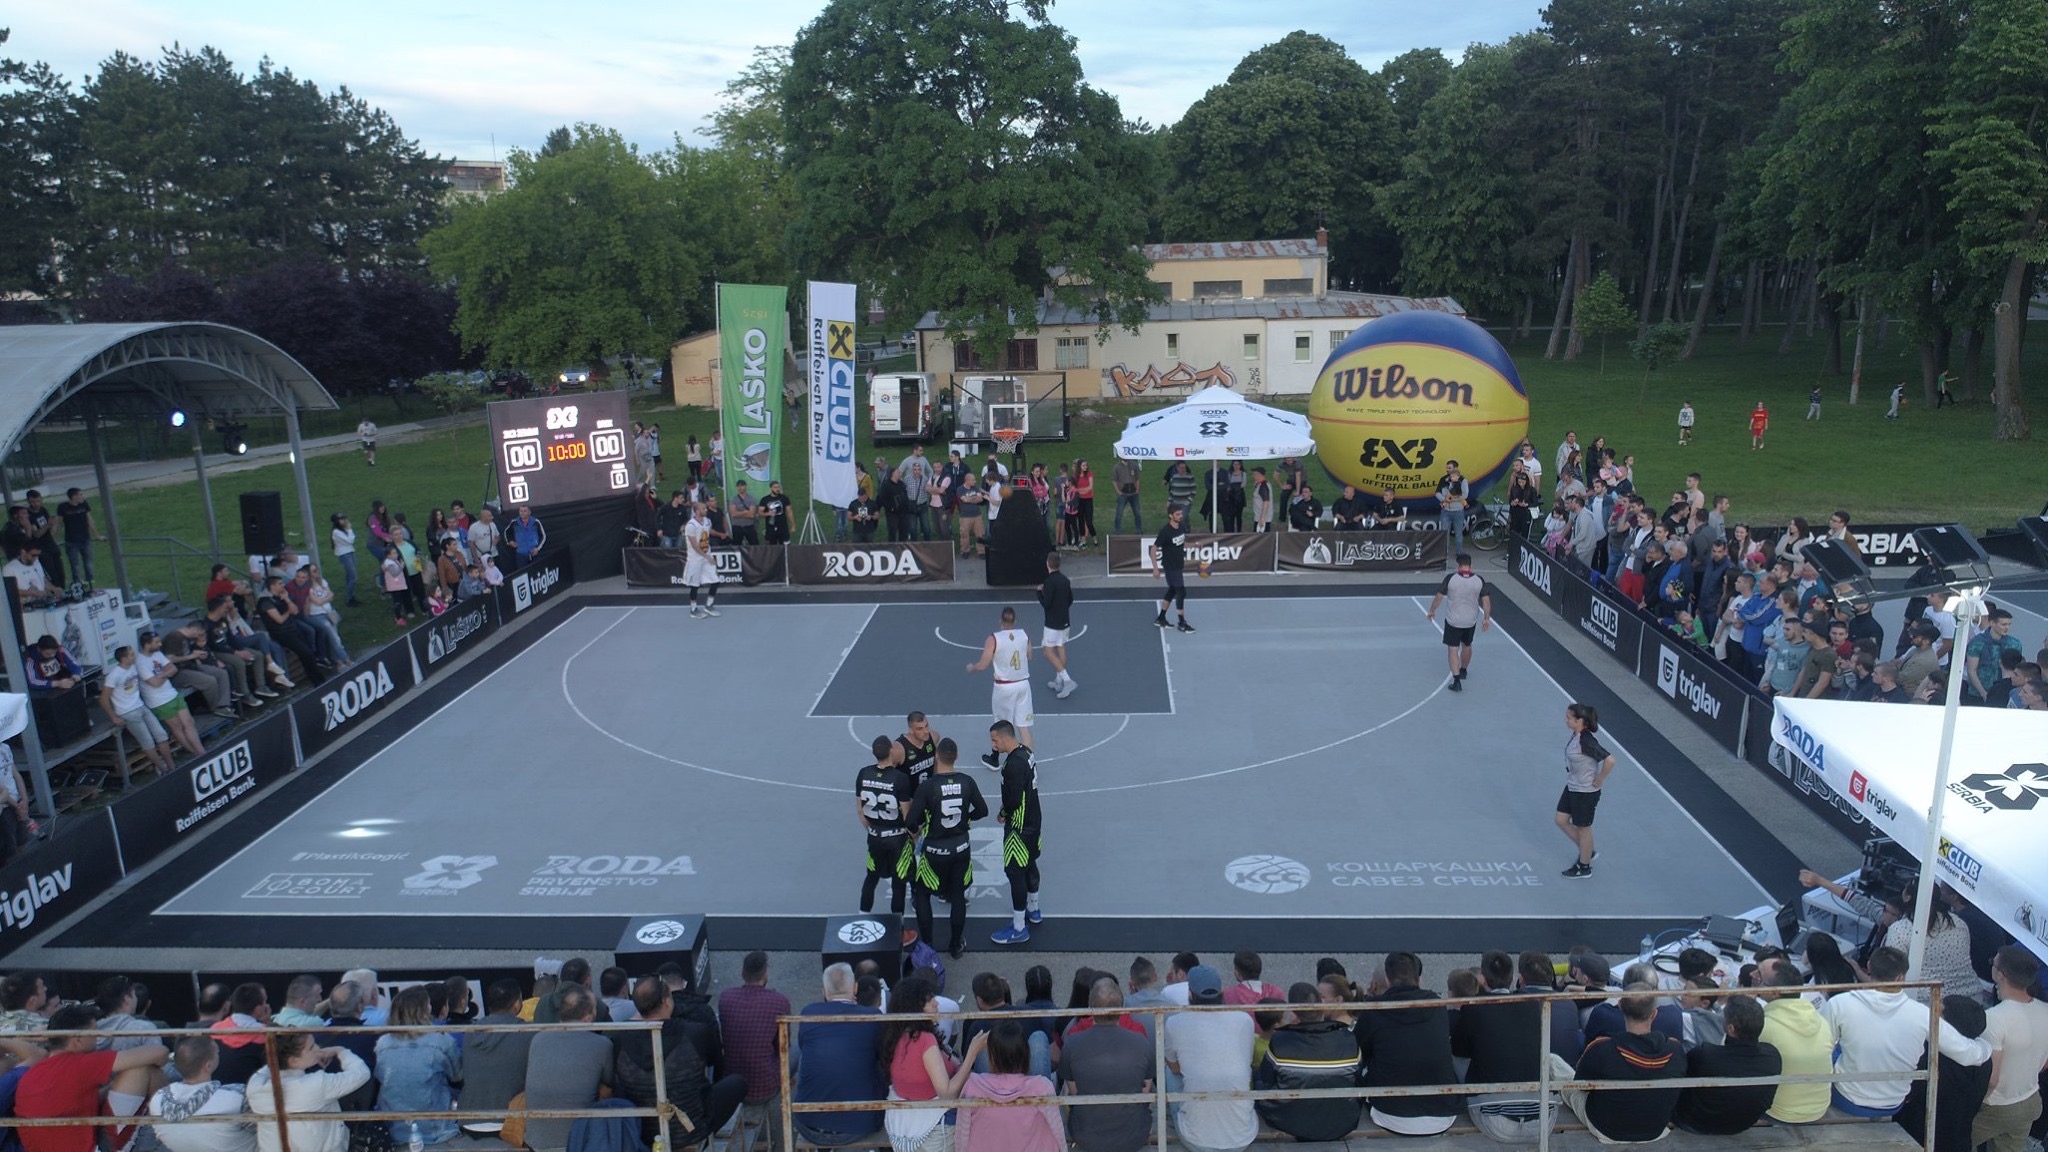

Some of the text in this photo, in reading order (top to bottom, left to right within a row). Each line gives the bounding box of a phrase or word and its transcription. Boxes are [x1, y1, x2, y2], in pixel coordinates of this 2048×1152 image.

[739, 328, 772, 435] LAŠKO
[813, 317, 824, 456] Raiffeisen Bank
[1333, 364, 1473, 408] Wilson
[829, 361, 853, 459] CLUB
[510, 445, 536, 467] 00
[547, 442, 586, 461] 10:00
[596, 435, 620, 456] 00
[1122, 447, 1158, 456] RODA
[1362, 478, 1438, 489] OFFICIAL BALL
[1375, 473, 1422, 482] FIBA 3x3
[822, 550, 922, 577] RODA
[1335, 540, 1410, 566] LAŠKO
[530, 566, 560, 596] triglav
[1520, 545, 1552, 597] RODA
[1591, 598, 1618, 635] CLUB
[1580, 616, 1617, 651] Raiffeisen Bank
[1010, 650, 1021, 671] 4
[321, 661, 394, 732] RODA
[1679, 669, 1721, 720] triglav
[1781, 714, 1825, 771] RODA
[194, 744, 250, 795] CLUB
[175, 776, 256, 833] Raiffeisen Bank
[860, 790, 899, 821] 23
[1866, 788, 1897, 822] triglav
[1945, 782, 1994, 814] SERBIA
[940, 798, 963, 829] 5
[533, 855, 698, 876] RODA
[1326, 861, 1534, 873] КОШАРКАШКИ
[1948, 847, 1981, 881] CLUB
[288, 886, 371, 895] COURT
[297, 878, 365, 886] BOMA
[518, 887, 598, 897] SRBIJE
[526, 877, 659, 887] PRVENSTVO
[1331, 875, 1544, 887] САВЕЗ СРБИЈЕ
[1960, 874, 1977, 892] Bank
[0, 862, 73, 932] riglav
[640, 930, 679, 939] KSS
